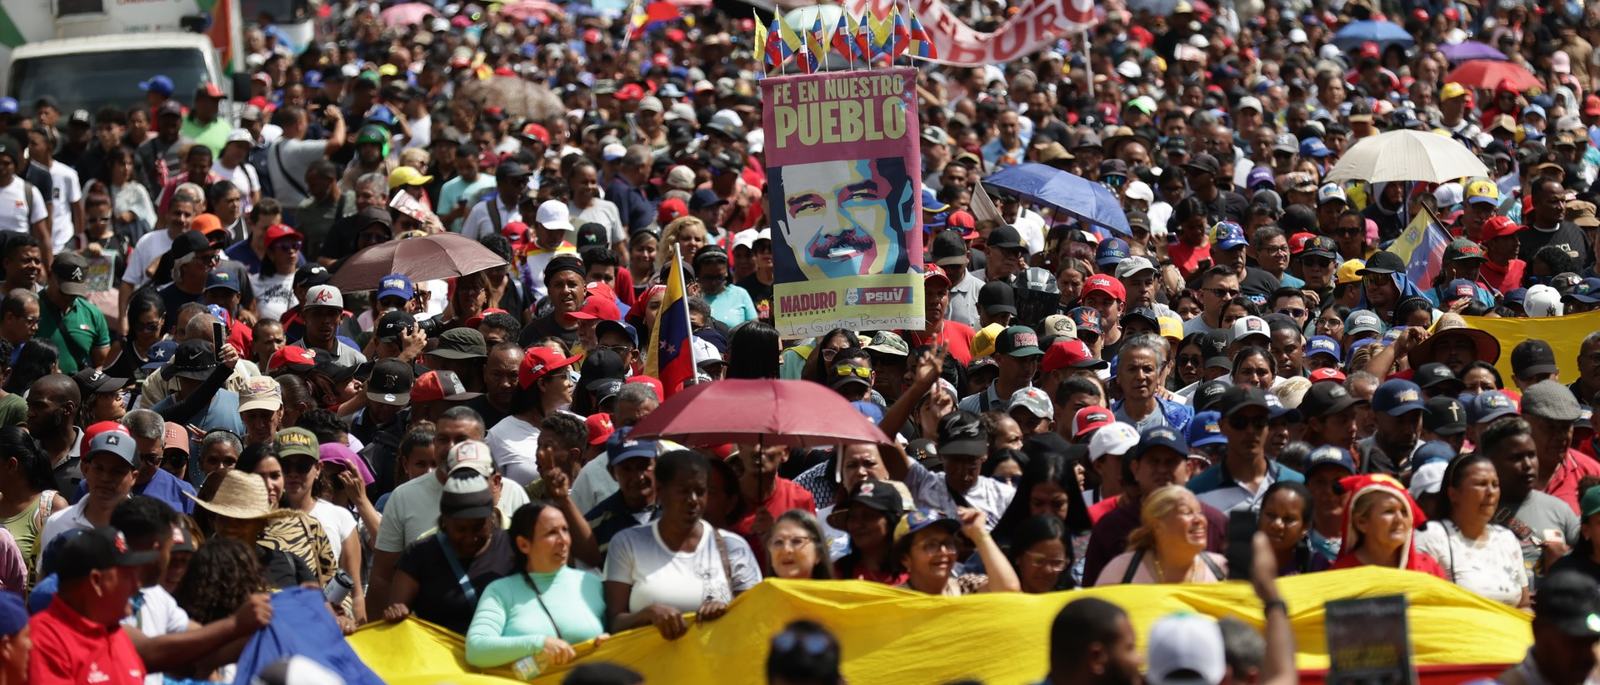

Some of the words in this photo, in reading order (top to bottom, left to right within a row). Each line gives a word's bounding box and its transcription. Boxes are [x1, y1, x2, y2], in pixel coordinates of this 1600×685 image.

[773, 83, 792, 104] FE
[798, 80, 819, 102] EN
[825, 74, 905, 100] NUESTRO
[774, 96, 907, 148] PUEBLO
[780, 290, 837, 313] MADURO
[865, 288, 904, 302] PSUV
[781, 308, 837, 317] PRESIDENTE
